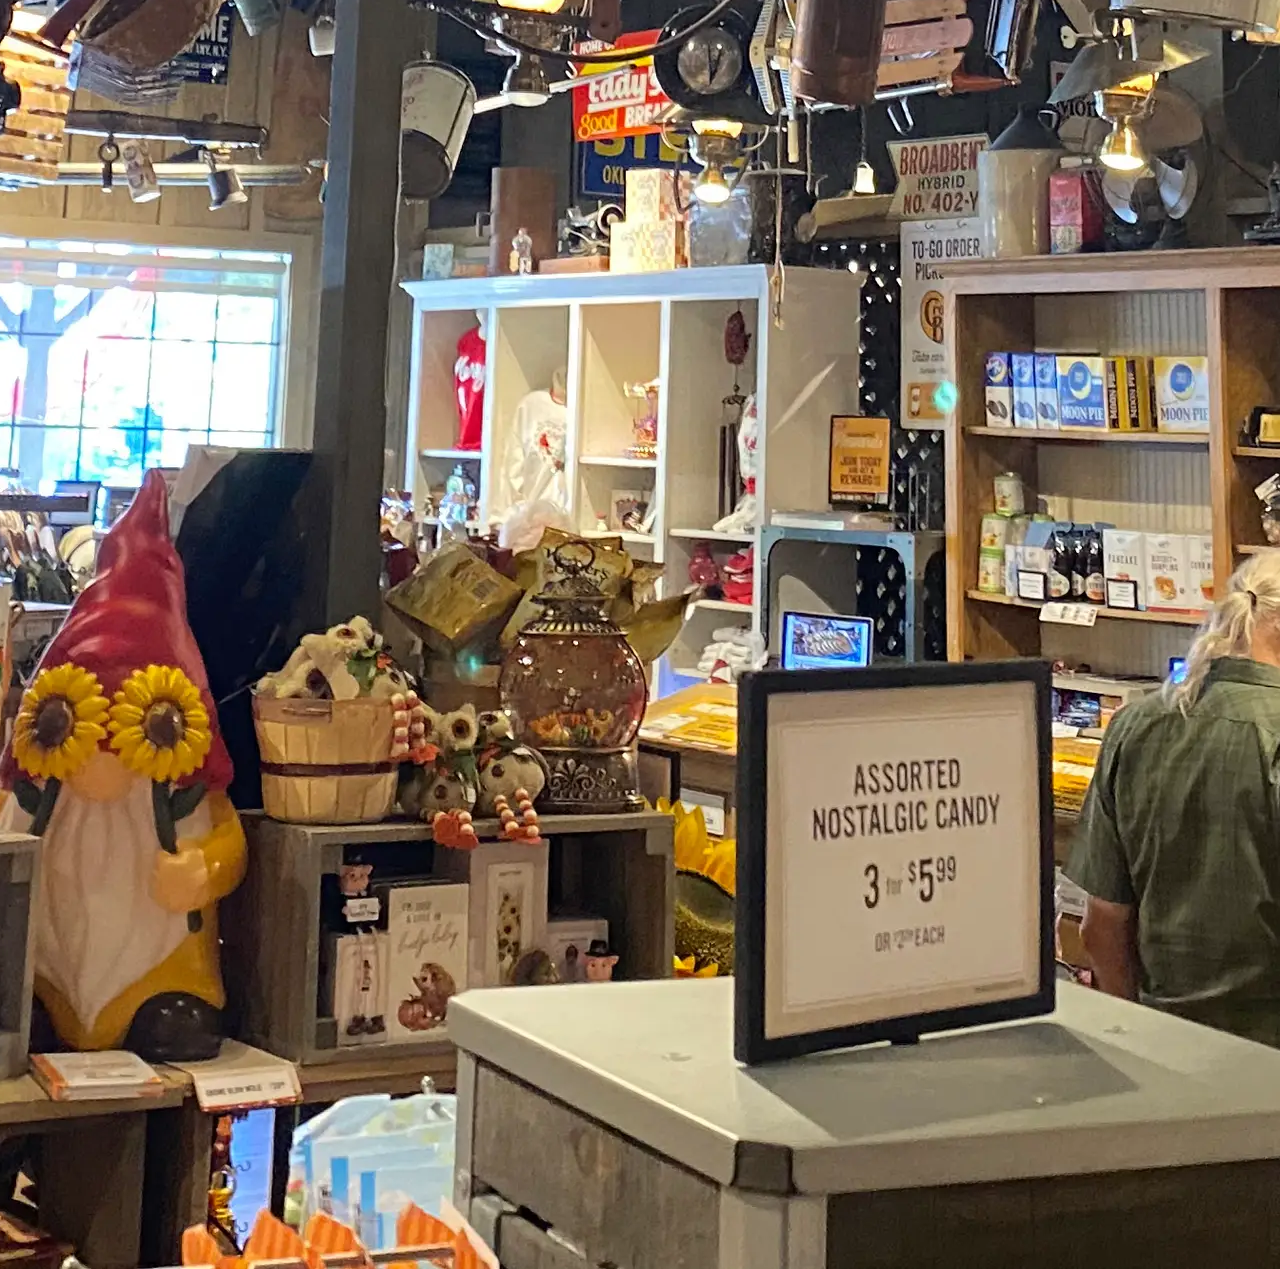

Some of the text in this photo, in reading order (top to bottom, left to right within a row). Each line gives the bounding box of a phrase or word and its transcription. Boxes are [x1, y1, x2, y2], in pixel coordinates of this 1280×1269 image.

[200, 15, 230, 43] ME
[578, 108, 618, 139] good
[624, 102, 670, 129] BREA
[899, 139, 987, 176] BROADBENT
[917, 175, 966, 192] HYBRID
[903, 190, 980, 215] NO. 402-Y
[911, 238, 983, 260] TO-GO ORDER
[1061, 406, 1090, 421] MOON
[1160, 407, 1192, 421] MOON
[1108, 554, 1139, 566] PANCAKE
[853, 758, 962, 797] ASSORTED
[812, 794, 1001, 842] NOSTALGIC CANDY
[864, 863, 880, 909] 3
[874, 931, 891, 953] OR
[914, 925, 946, 948] EACH
